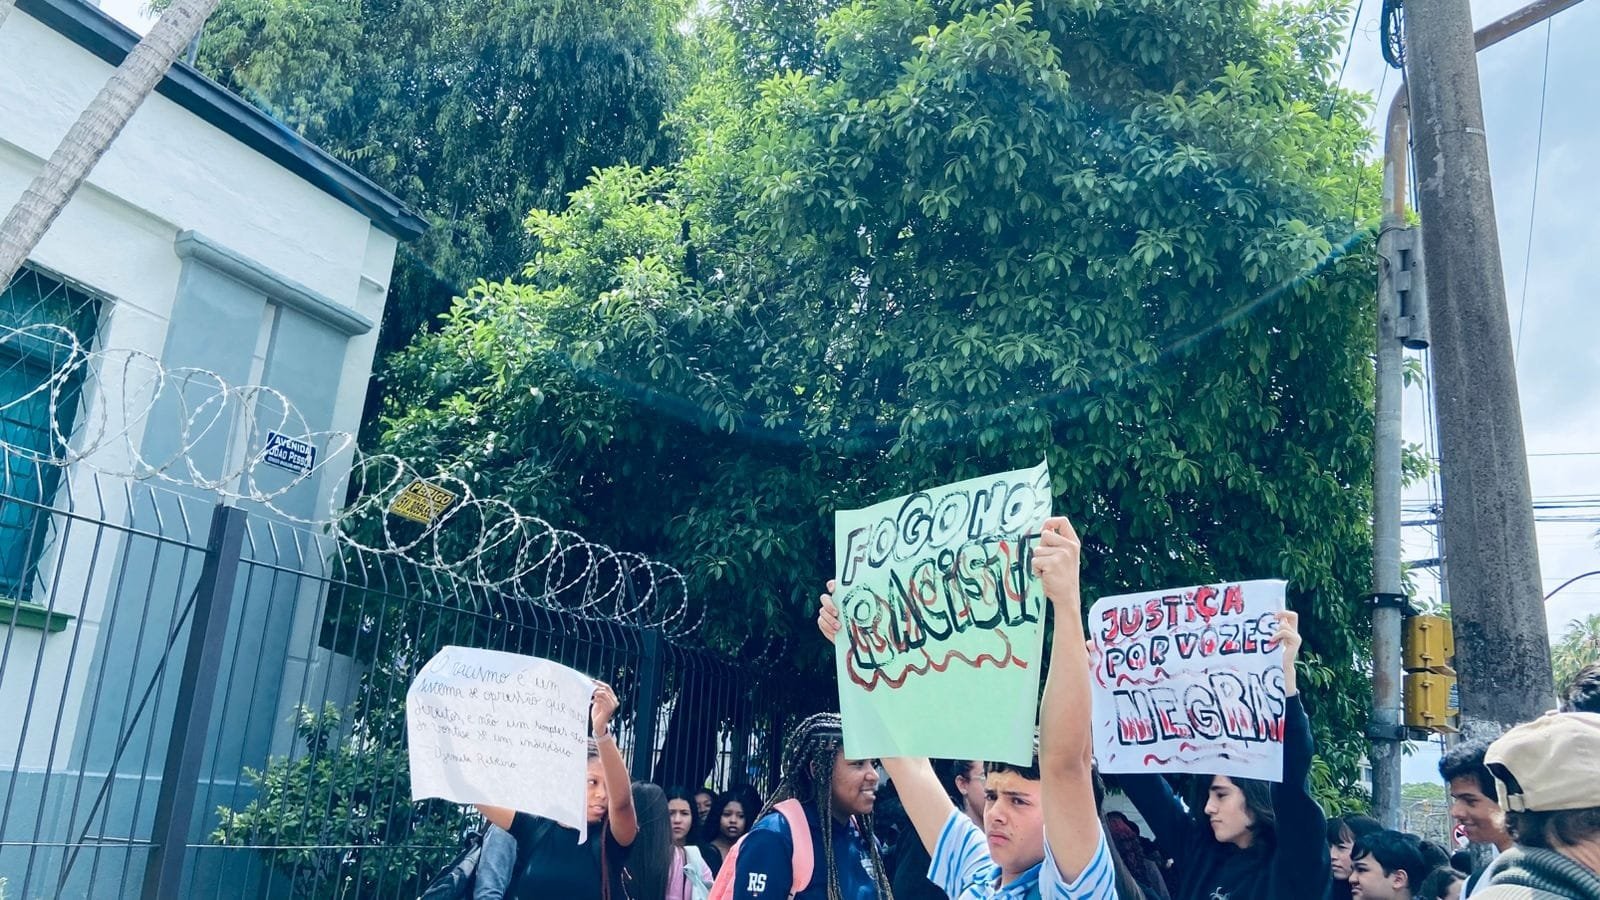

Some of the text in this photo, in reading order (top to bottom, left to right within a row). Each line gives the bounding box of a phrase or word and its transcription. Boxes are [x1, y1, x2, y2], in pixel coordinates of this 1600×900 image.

[274, 436, 311, 455] AVENIDA
[410, 482, 452, 504] PERIGO
[1106, 612, 1281, 678] POR VOZES
[517, 669, 528, 686] é
[535, 677, 561, 697] um
[1113, 665, 1286, 746] NEGRAS
[747, 872, 767, 892] RS
